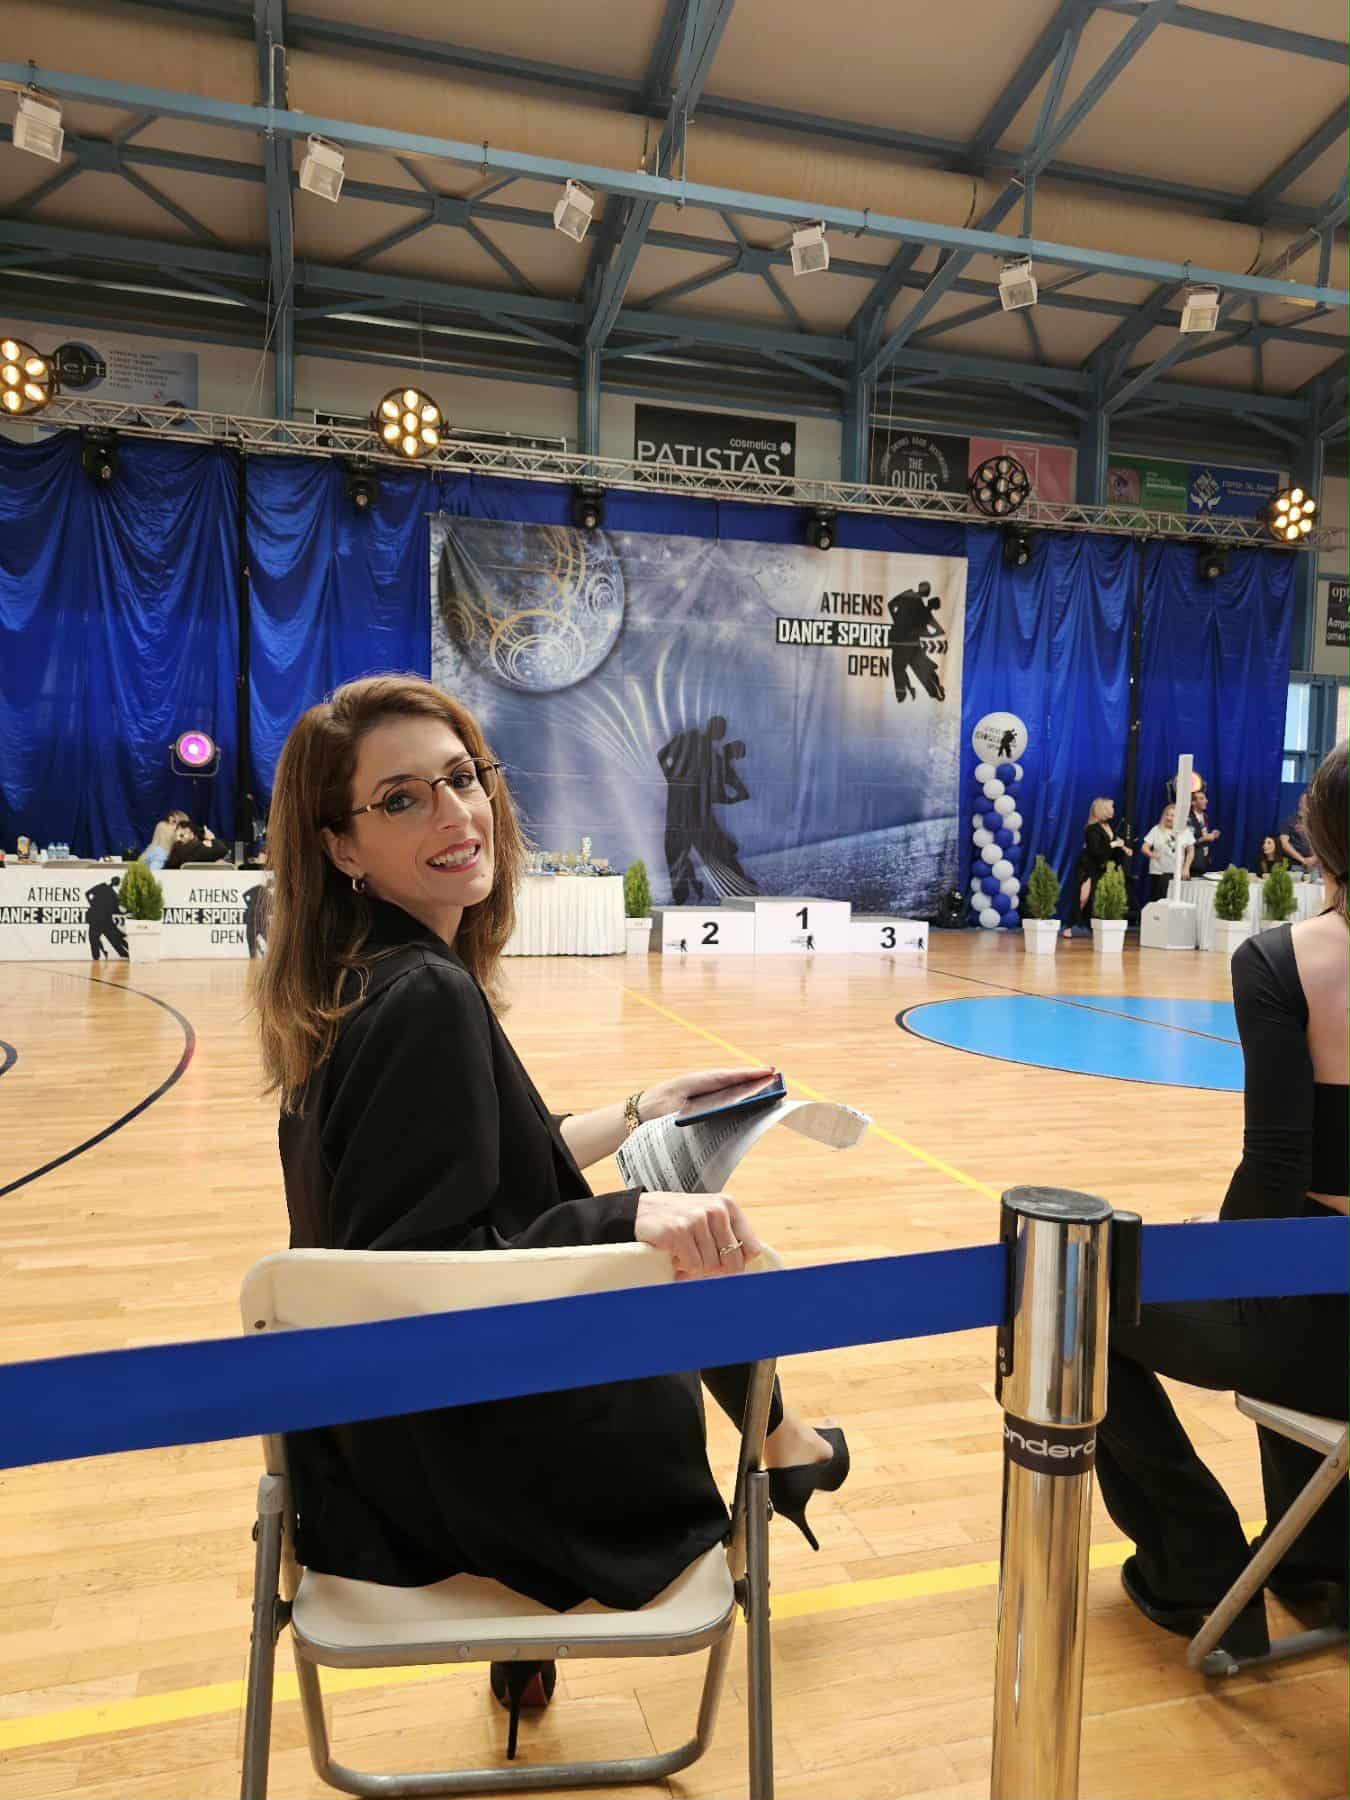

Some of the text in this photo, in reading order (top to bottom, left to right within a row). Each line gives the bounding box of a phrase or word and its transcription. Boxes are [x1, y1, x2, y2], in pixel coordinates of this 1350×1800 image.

[730, 438, 777, 451] cosmetics
[637, 440, 781, 476] PATISTAS
[908, 457, 923, 471] THE
[820, 592, 884, 616] ATHENS
[778, 619, 892, 647] DANCE SPORT
[847, 655, 889, 677] OPEN
[27, 887, 80, 902] ATHENS
[188, 888, 239, 903] ATHENS
[0, 907, 89, 924] ANCE SPORT
[161, 908, 246, 924] ANCE SPORT
[795, 907, 808, 929] 1
[50, 930, 87, 944] OPEN
[210, 930, 244, 944] OPEN
[701, 921, 719, 944] 2
[880, 926, 896, 948] 3
